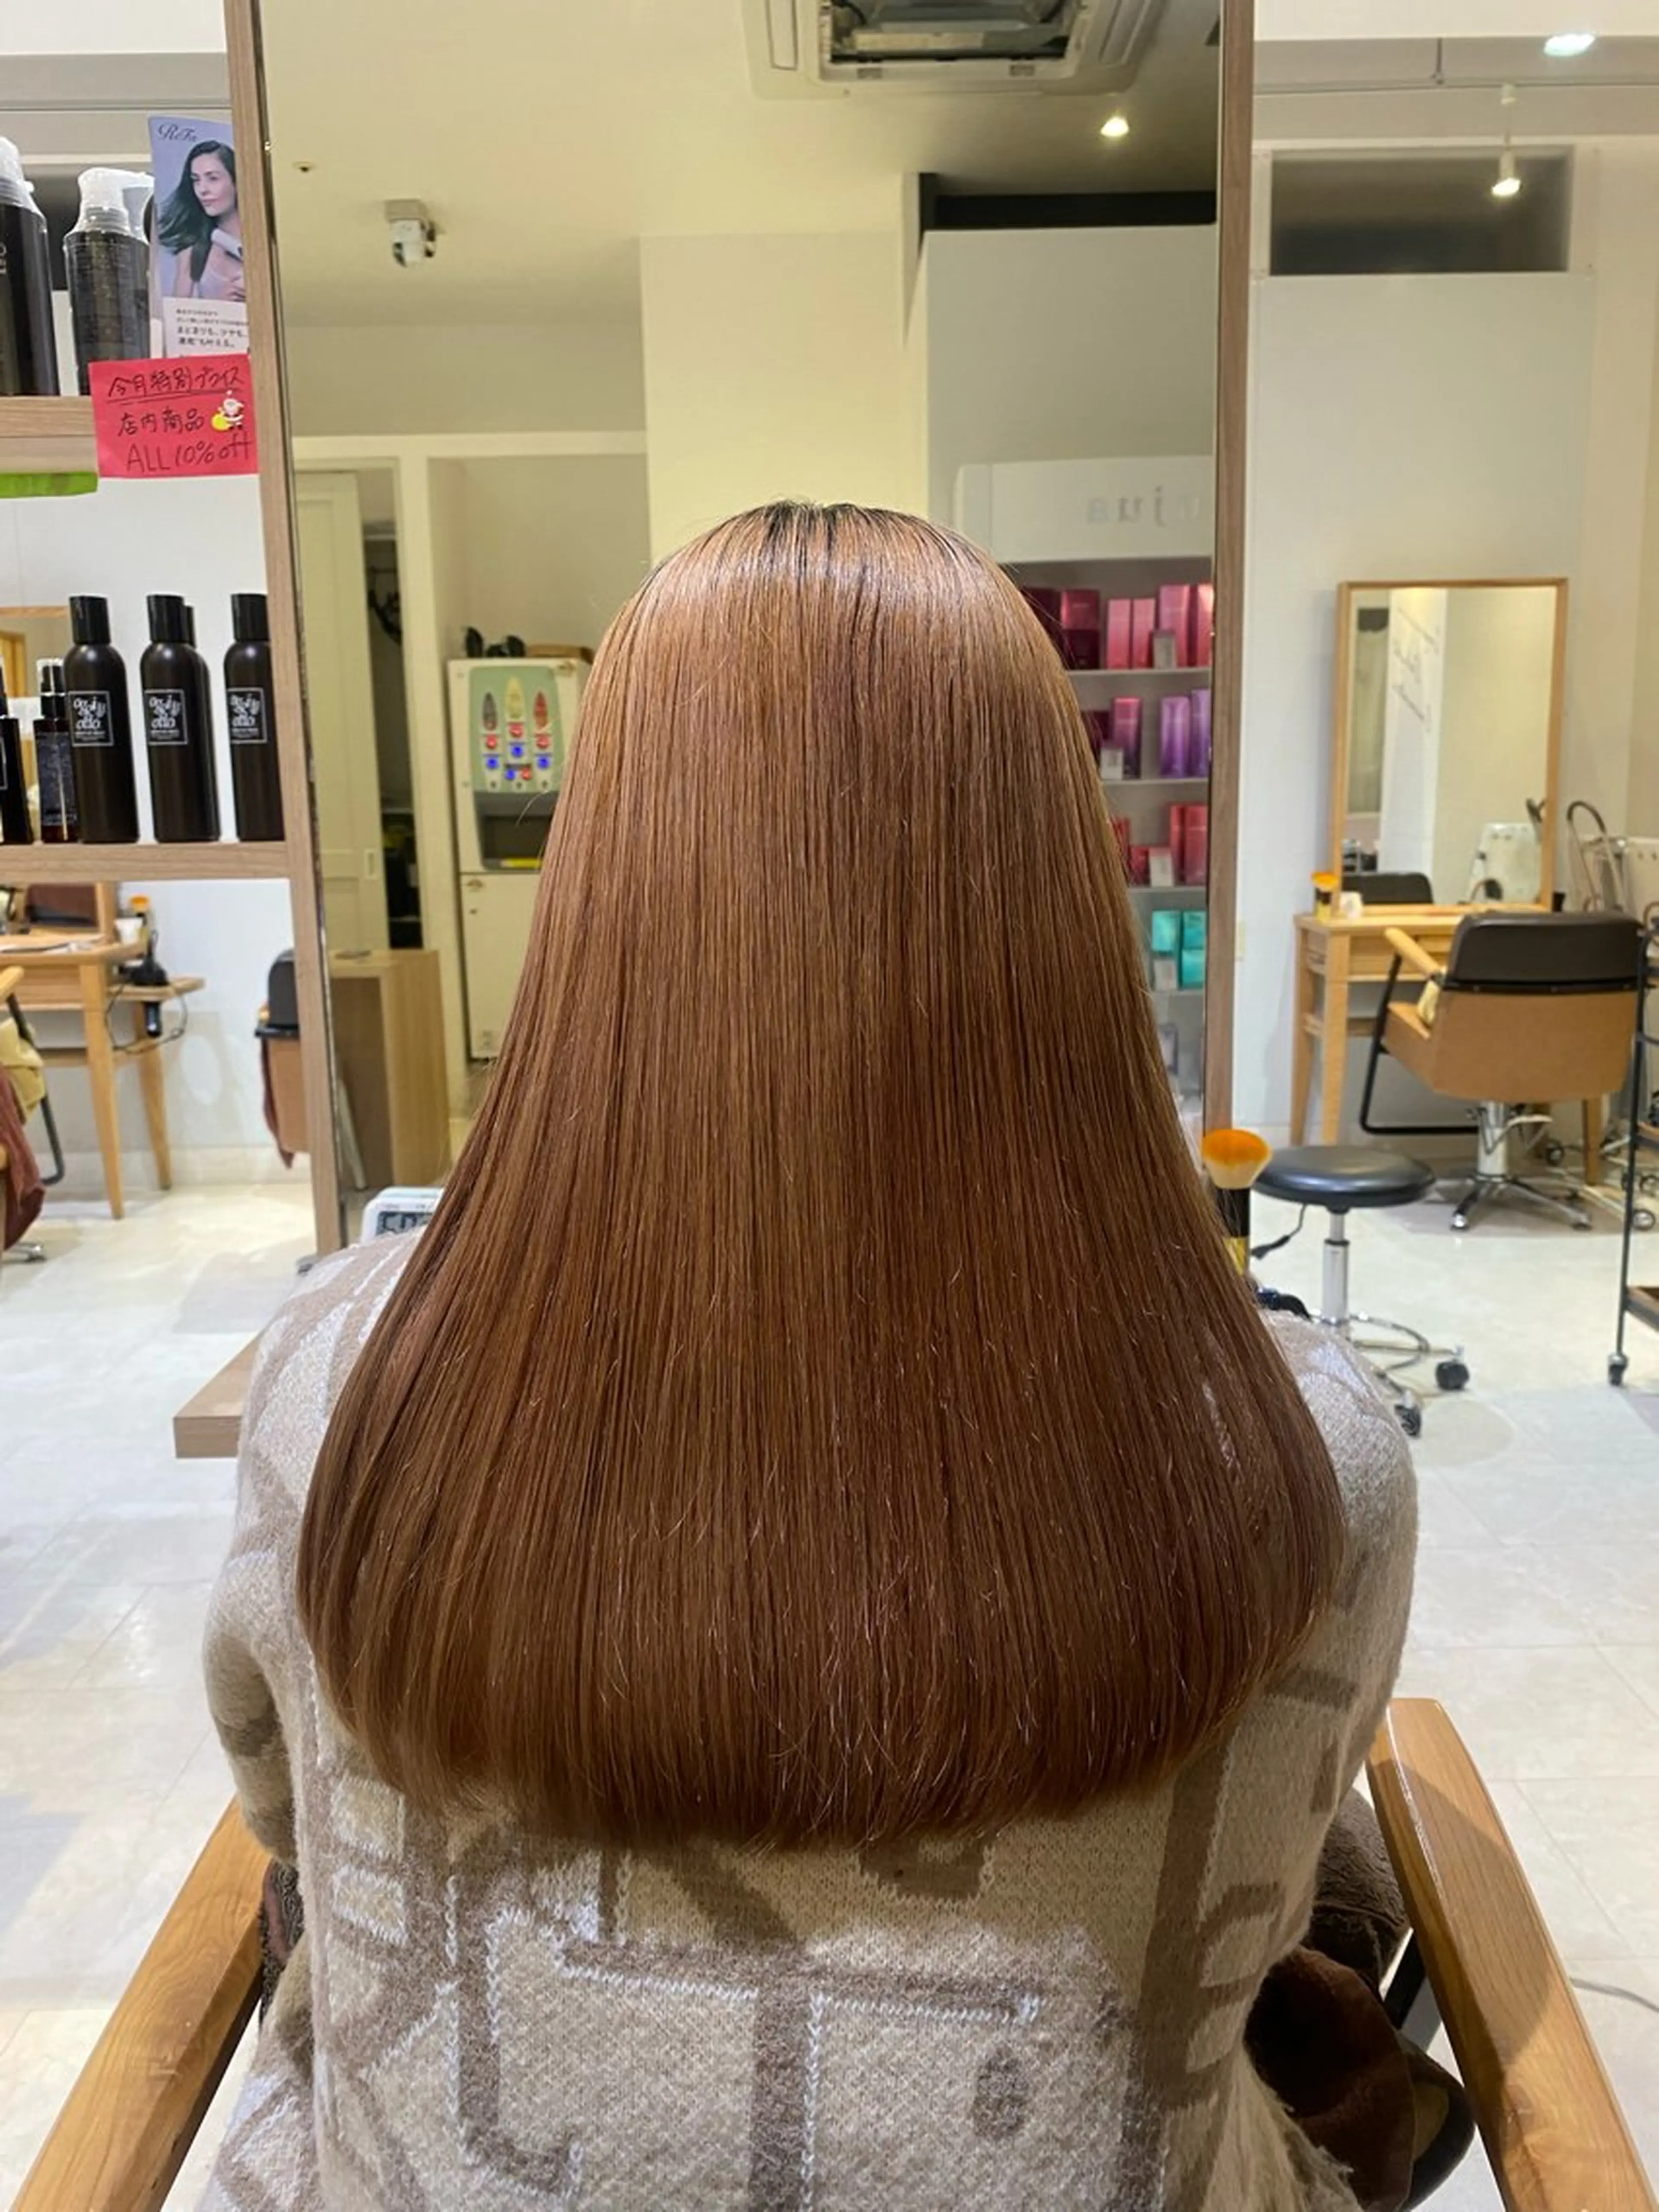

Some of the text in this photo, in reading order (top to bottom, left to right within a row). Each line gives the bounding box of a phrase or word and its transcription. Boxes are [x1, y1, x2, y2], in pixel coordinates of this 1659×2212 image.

[118, 406, 204, 436] 店内商品
[127, 442, 171, 473] ALL
[175, 441, 216, 467] 10%
